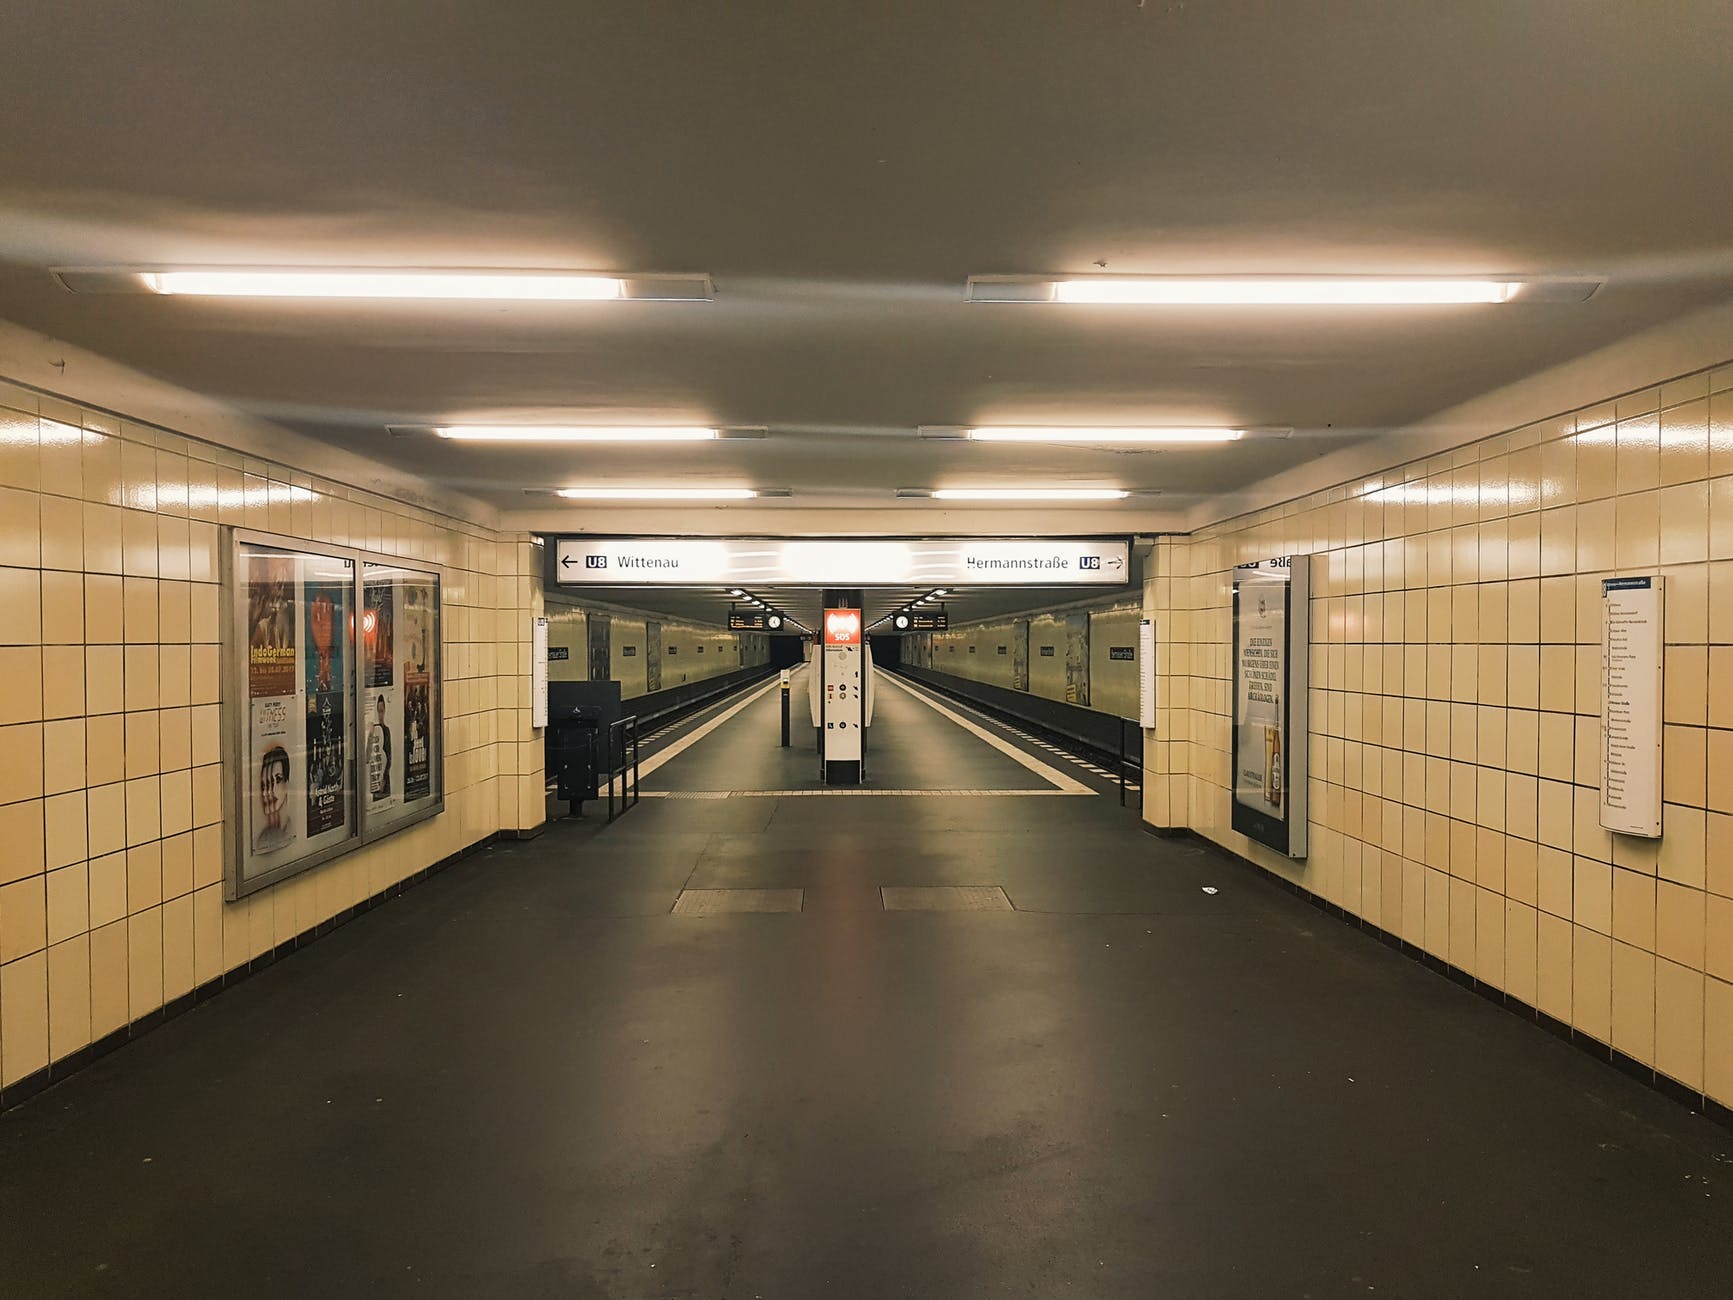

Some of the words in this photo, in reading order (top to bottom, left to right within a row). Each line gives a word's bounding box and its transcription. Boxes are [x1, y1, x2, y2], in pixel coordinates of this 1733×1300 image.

[587, 556, 607, 568] U8
[618, 556, 679, 568] Wittenau
[967, 556, 1069, 569] Hermannstraße
[1080, 557, 1100, 569] U8
[834, 633, 851, 641] SOS
